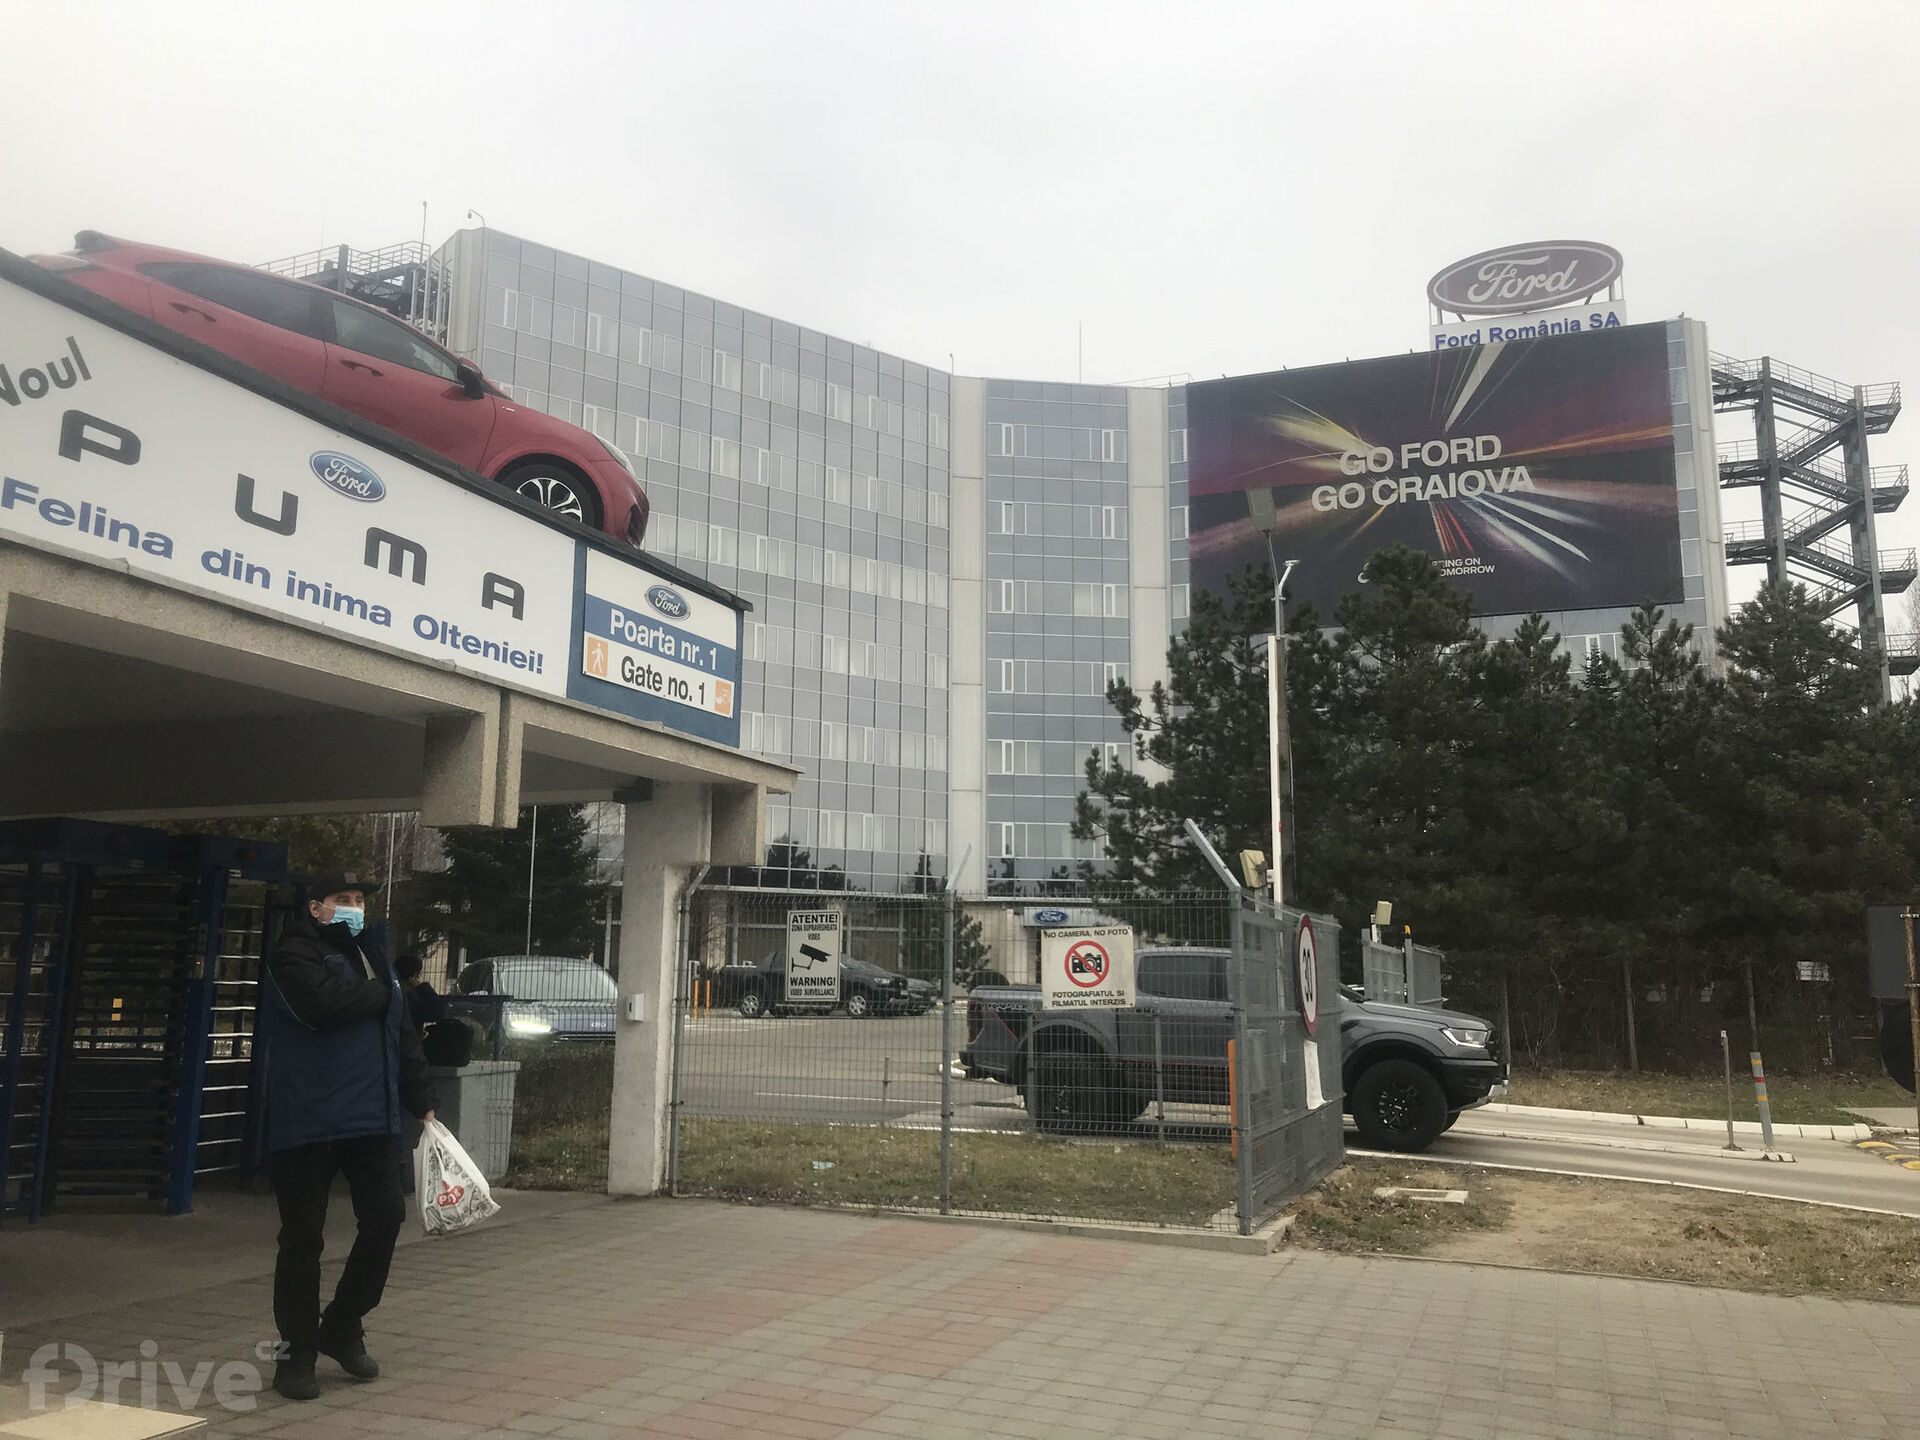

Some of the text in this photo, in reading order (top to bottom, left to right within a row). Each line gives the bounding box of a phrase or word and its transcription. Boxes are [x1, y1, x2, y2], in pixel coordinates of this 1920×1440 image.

[1467, 255, 1579, 303] Ford
[1435, 311, 1621, 350] Ford România SA
[1340, 434, 1502, 476] GO FORD
[323, 457, 372, 497] Ford
[1311, 465, 1536, 511] GO CRAIOVA
[1440, 565, 1496, 577] OMORROW
[1464, 557, 1481, 566] ON
[1, 476, 544, 675] Felina din inima Olteniei!
[655, 589, 681, 616] Ford
[610, 608, 717, 671] Poarta nr. 1
[621, 655, 705, 705] Gate no. 1
[792, 913, 838, 924] ATENTIE!
[807, 932, 821, 941] VIDEO
[1045, 931, 1057, 939] NO
[1058, 930, 1092, 938] CAMERA,
[1107, 928, 1129, 936] FOTO
[790, 976, 836, 987] WARNING!
[1052, 990, 1114, 999] FOTOGRAFIATUL
[1051, 998, 1126, 1007] FILMATUL INTERZIS
